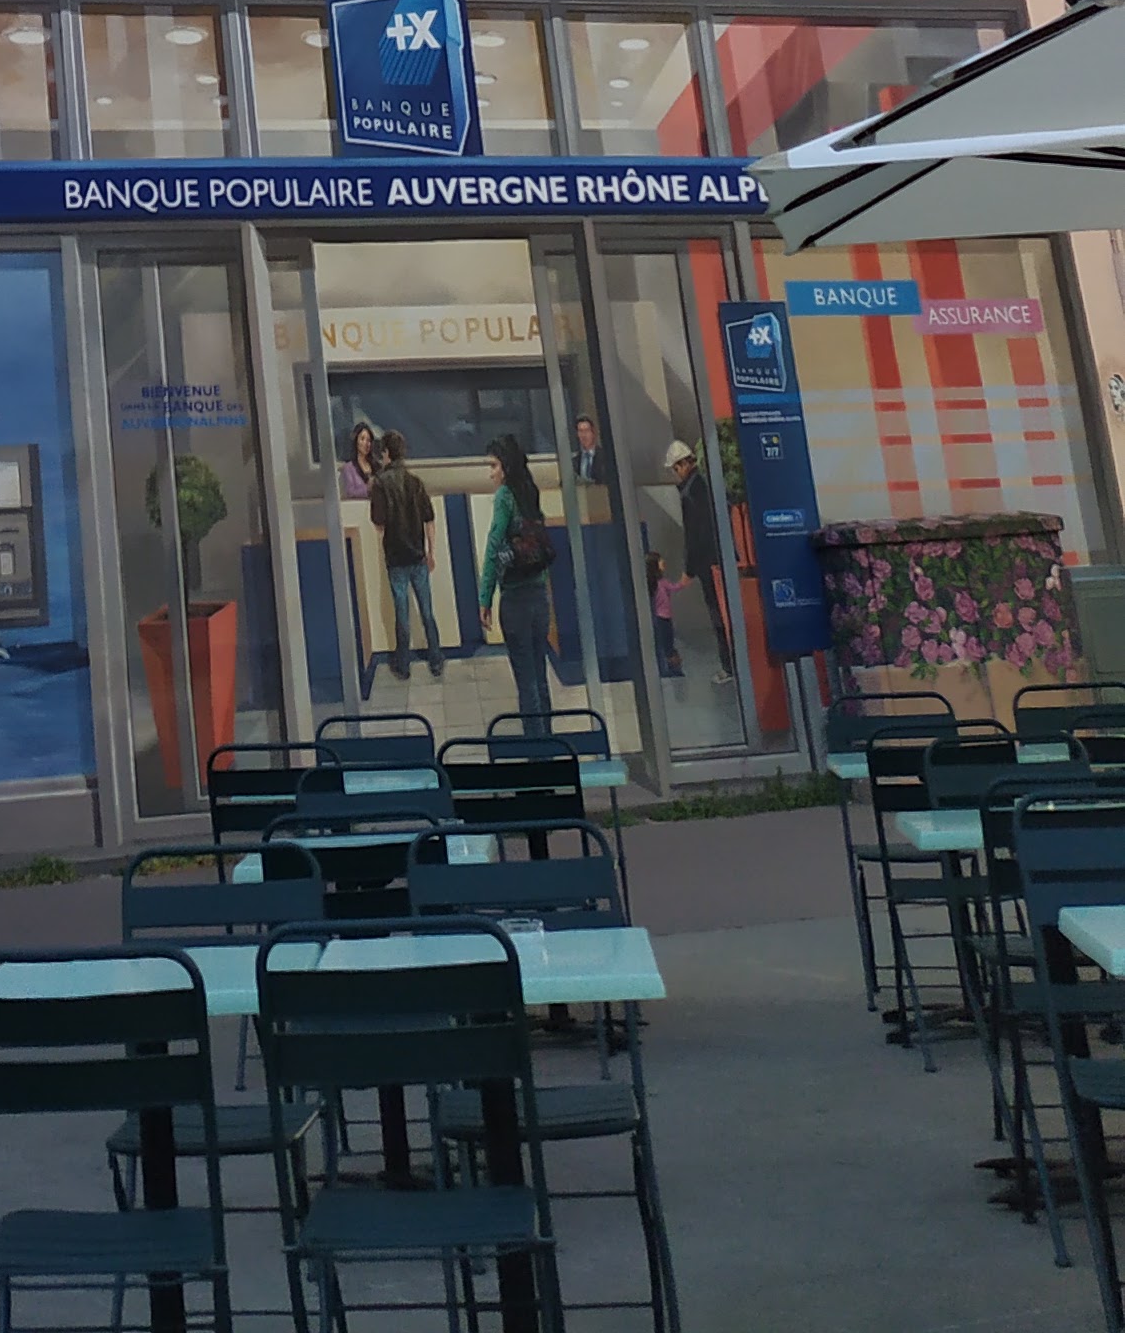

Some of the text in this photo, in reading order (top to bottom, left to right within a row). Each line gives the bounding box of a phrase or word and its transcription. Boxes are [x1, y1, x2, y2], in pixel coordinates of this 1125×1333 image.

[351, 97, 450, 117] BANQUE
[353, 116, 453, 140] POPULAIRE
[64, 178, 201, 213] BANQUE
[209, 177, 374, 209] POPULAIRE
[386, 177, 569, 206] AUVERGNE
[577, 167, 689, 204] RHÔNE
[813, 286, 898, 308] BANQUE
[929, 305, 1032, 326] ASSURANCE
[141, 385, 220, 398] BIENVENUE
[163, 400, 224, 413] BANQUE
